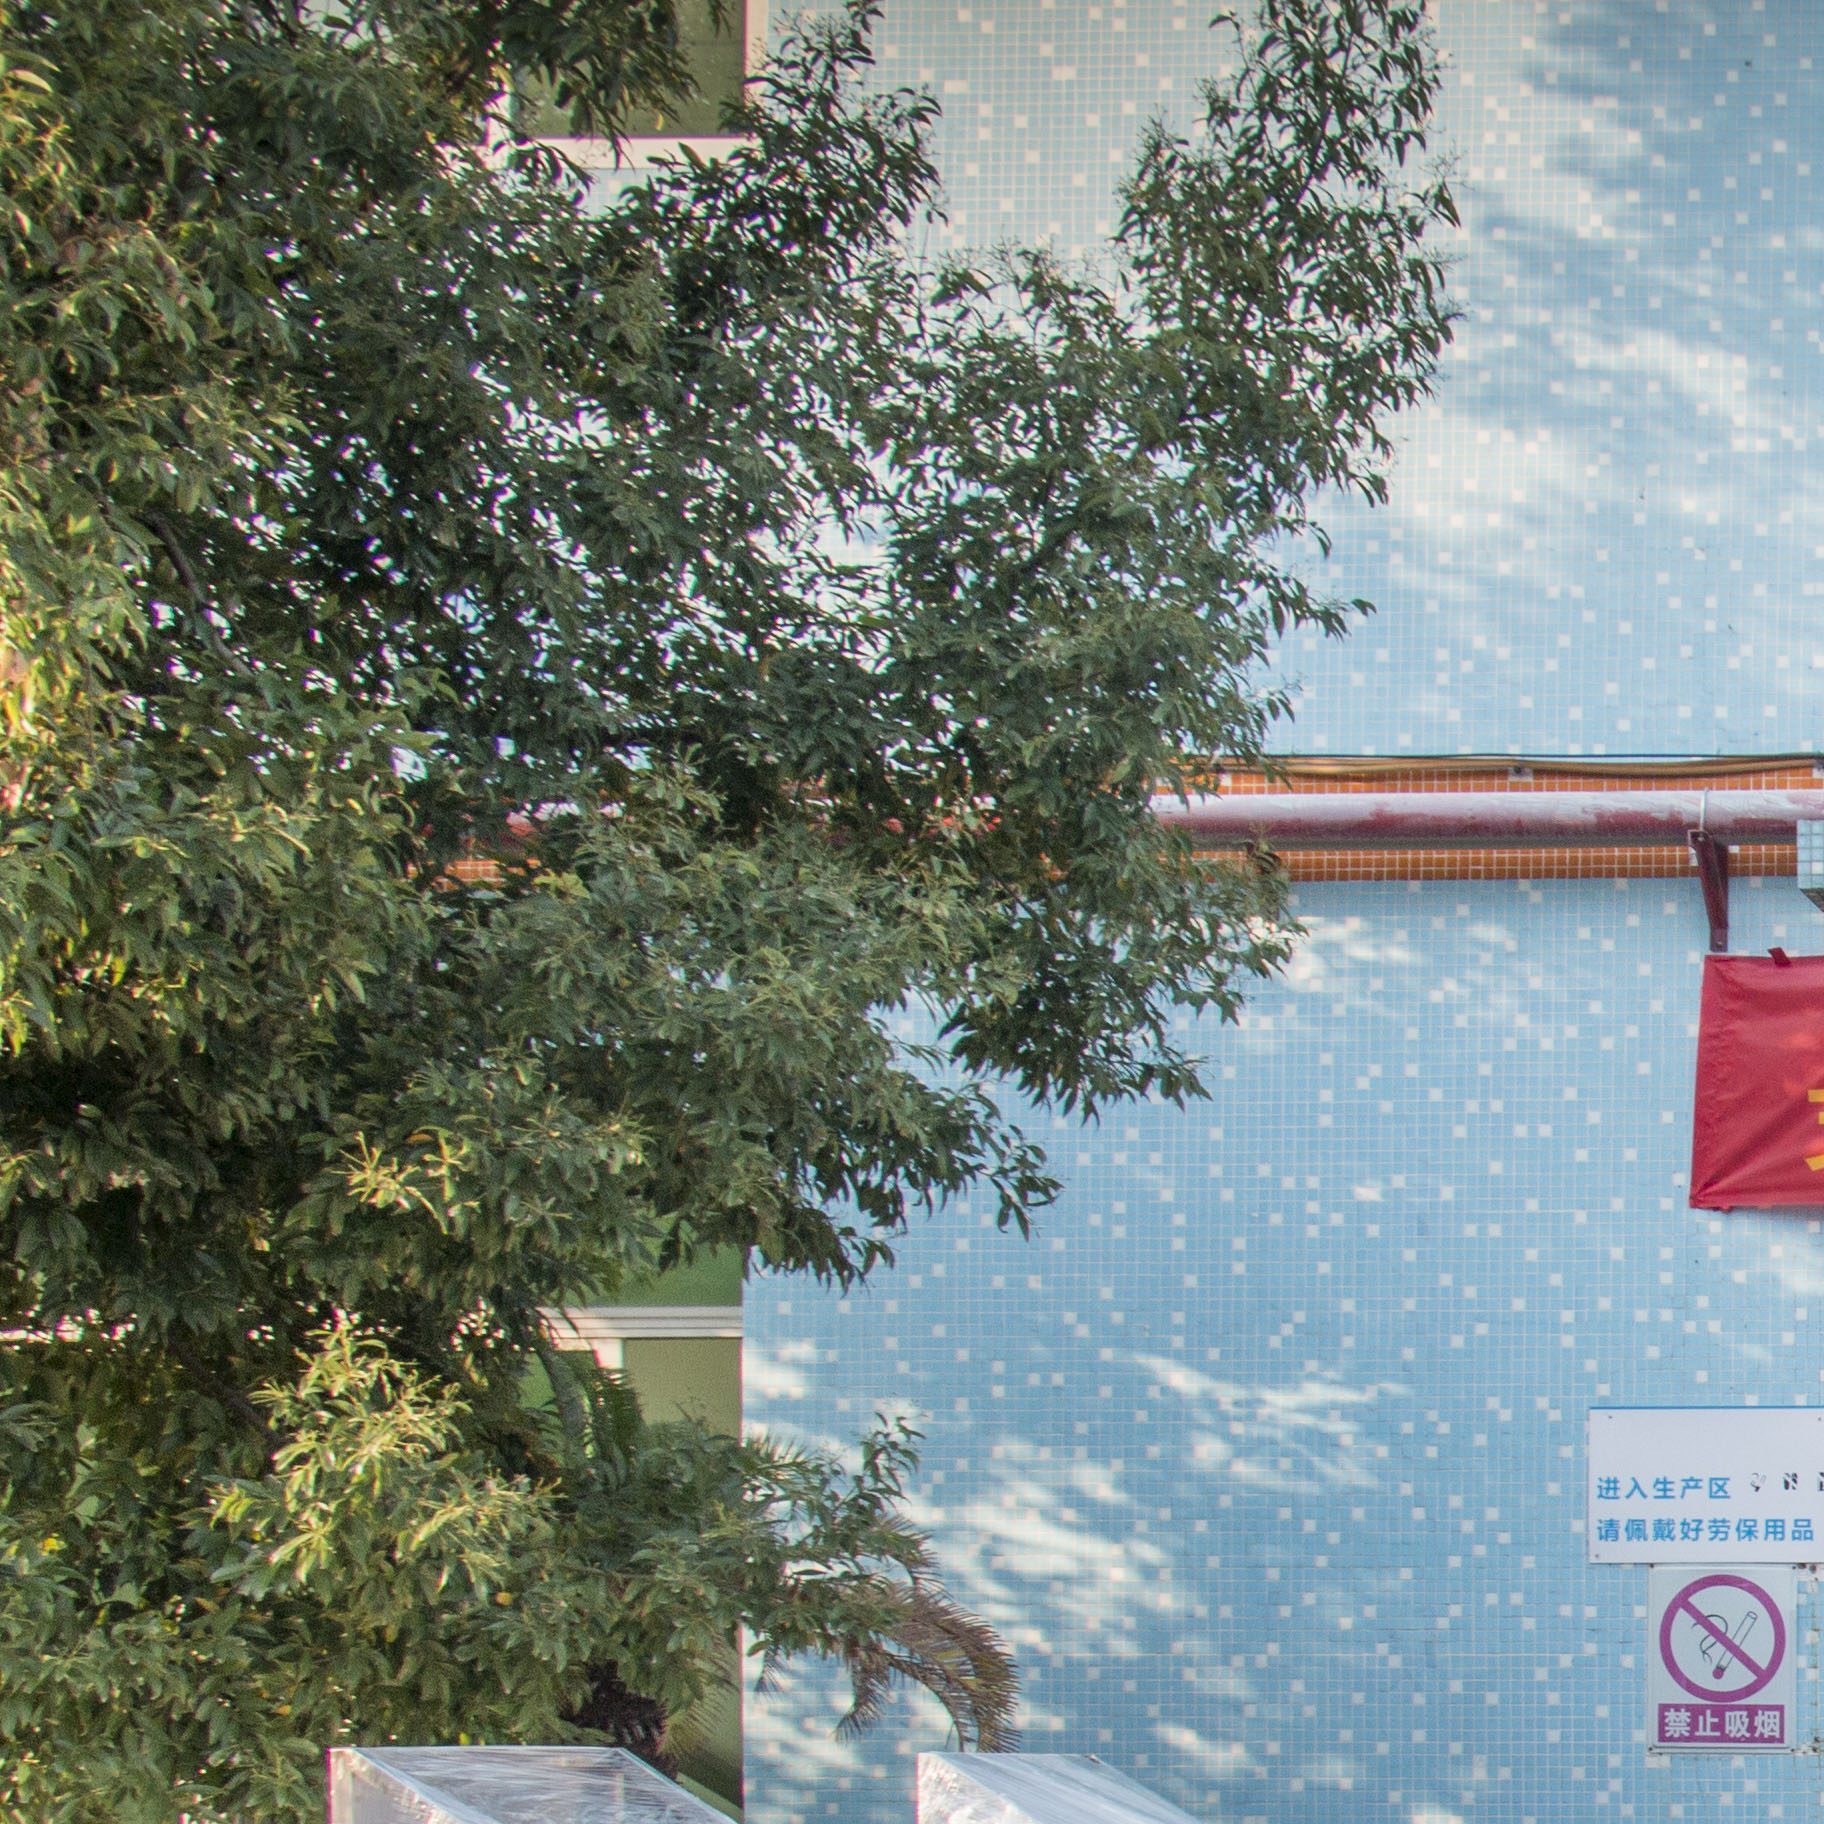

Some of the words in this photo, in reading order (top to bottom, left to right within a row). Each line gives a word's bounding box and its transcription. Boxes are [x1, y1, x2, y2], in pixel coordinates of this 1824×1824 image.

[1597, 1476, 1732, 1501] 进入生产区
[1597, 1517, 1815, 1543] 请佩戴好劳保用品
[1664, 1708, 1782, 1740] 禁止吸烟
